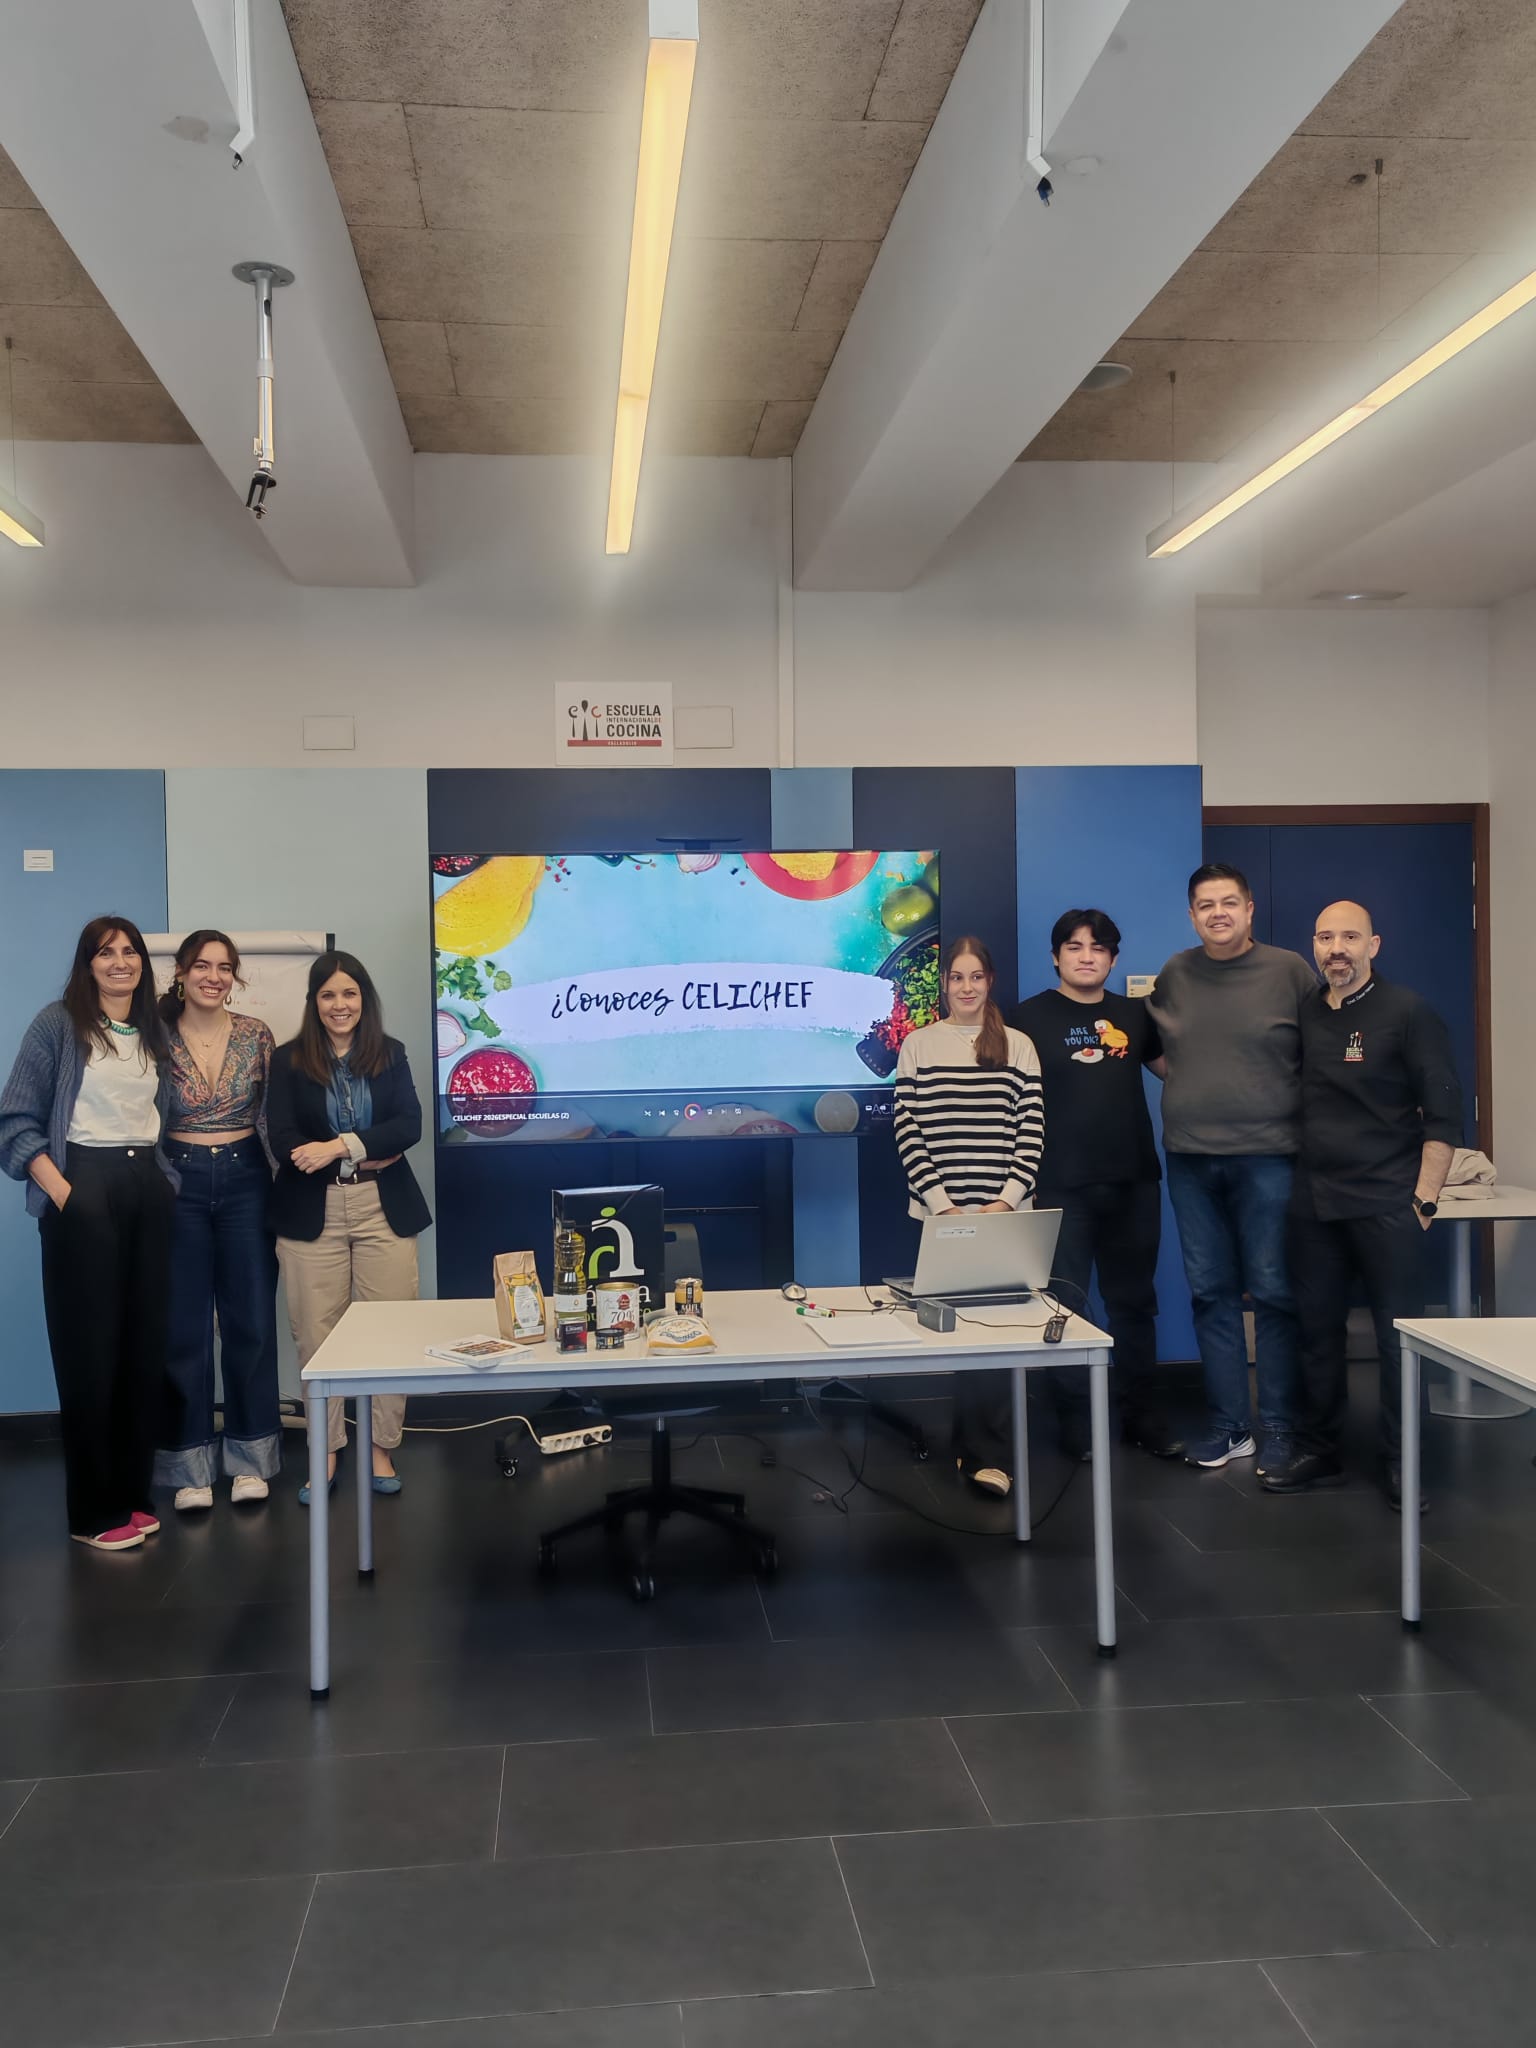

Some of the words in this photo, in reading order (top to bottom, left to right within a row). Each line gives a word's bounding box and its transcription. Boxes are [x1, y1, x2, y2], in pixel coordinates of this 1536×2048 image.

[606, 704, 661, 716] ESCUELA
[606, 724, 661, 737] COCINA
[551, 984, 674, 1019] ¿Conoces
[682, 980, 814, 1012] CELICHEF
[1070, 1026, 1088, 1036] ARE
[1065, 1036, 1081, 1046] YOU
[1083, 1035, 1099, 1045] OK?
